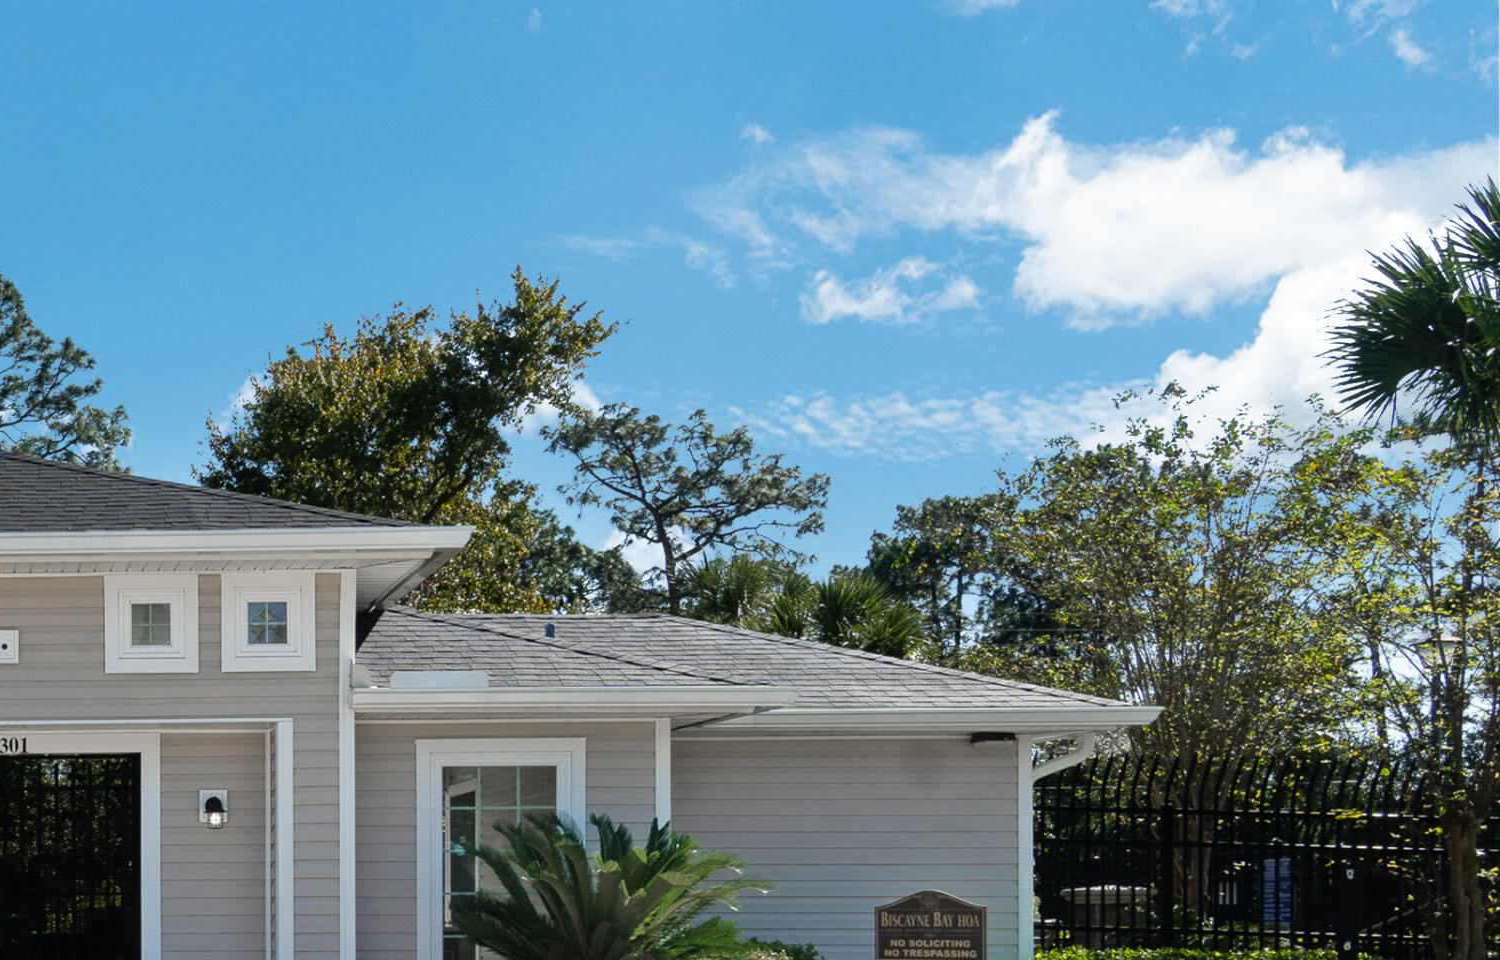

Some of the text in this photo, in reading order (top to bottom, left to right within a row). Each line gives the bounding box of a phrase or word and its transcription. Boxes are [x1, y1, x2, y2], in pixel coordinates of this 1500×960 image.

[881, 912, 980, 927] BISCAYNE BAY HOA
[890, 939, 971, 948] NO SOLICITING
[884, 949, 978, 958] NO TRESPASSING
